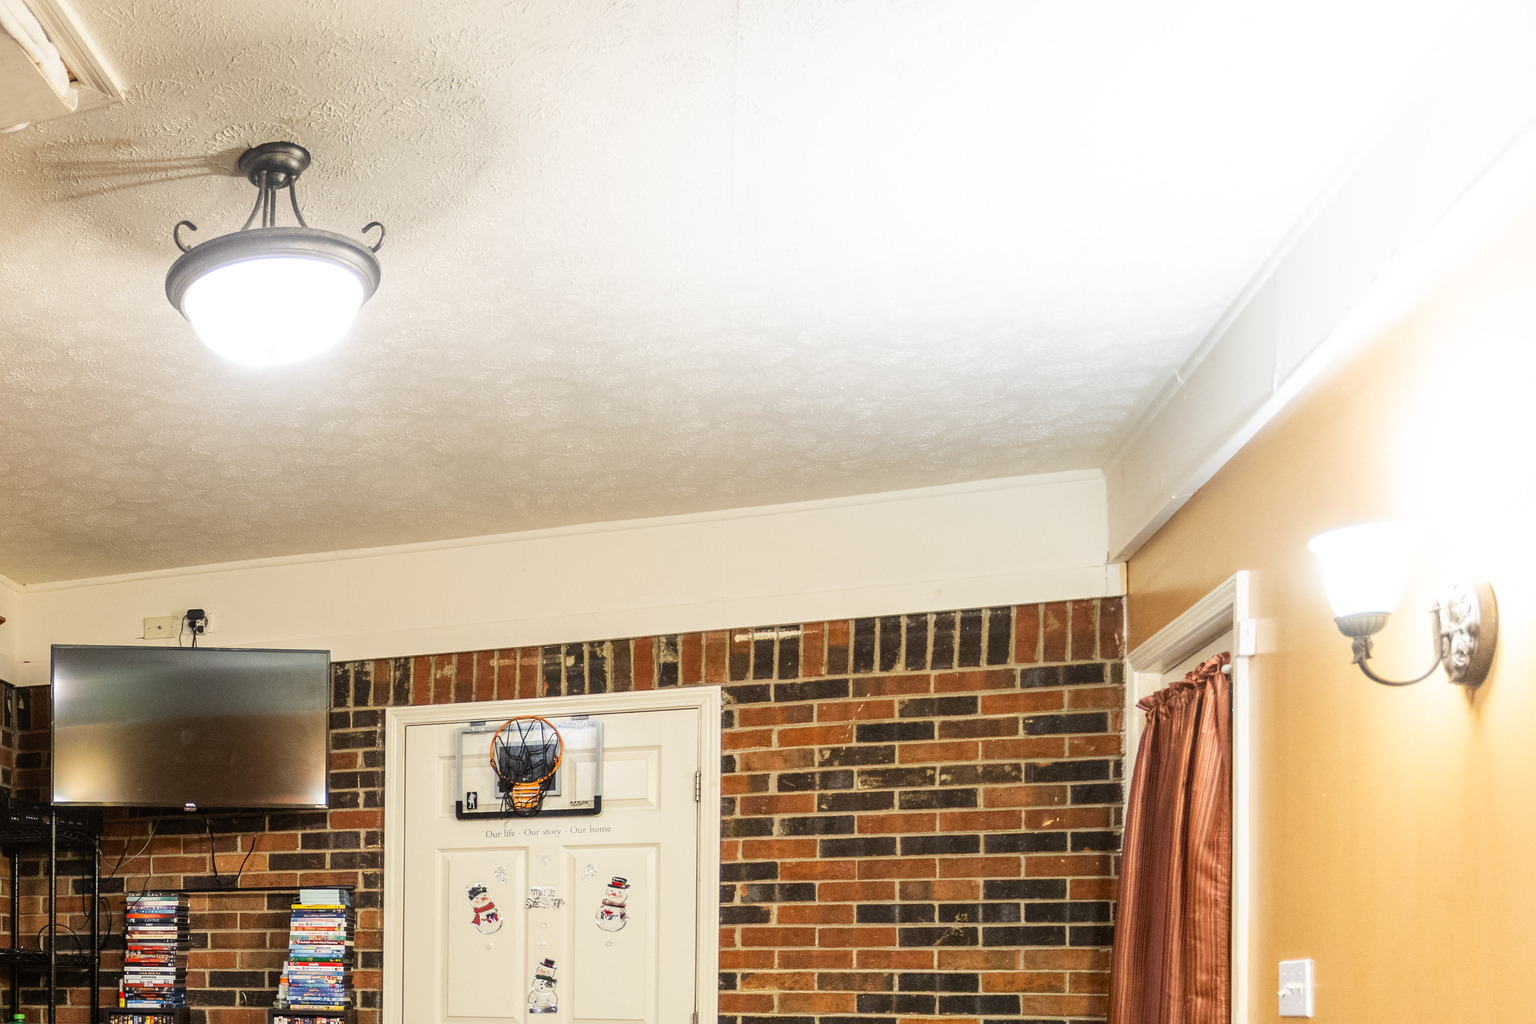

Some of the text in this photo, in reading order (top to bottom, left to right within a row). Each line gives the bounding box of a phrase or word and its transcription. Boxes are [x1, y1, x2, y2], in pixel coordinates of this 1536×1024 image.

[485, 825, 612, 839] Our life Our story Our home
